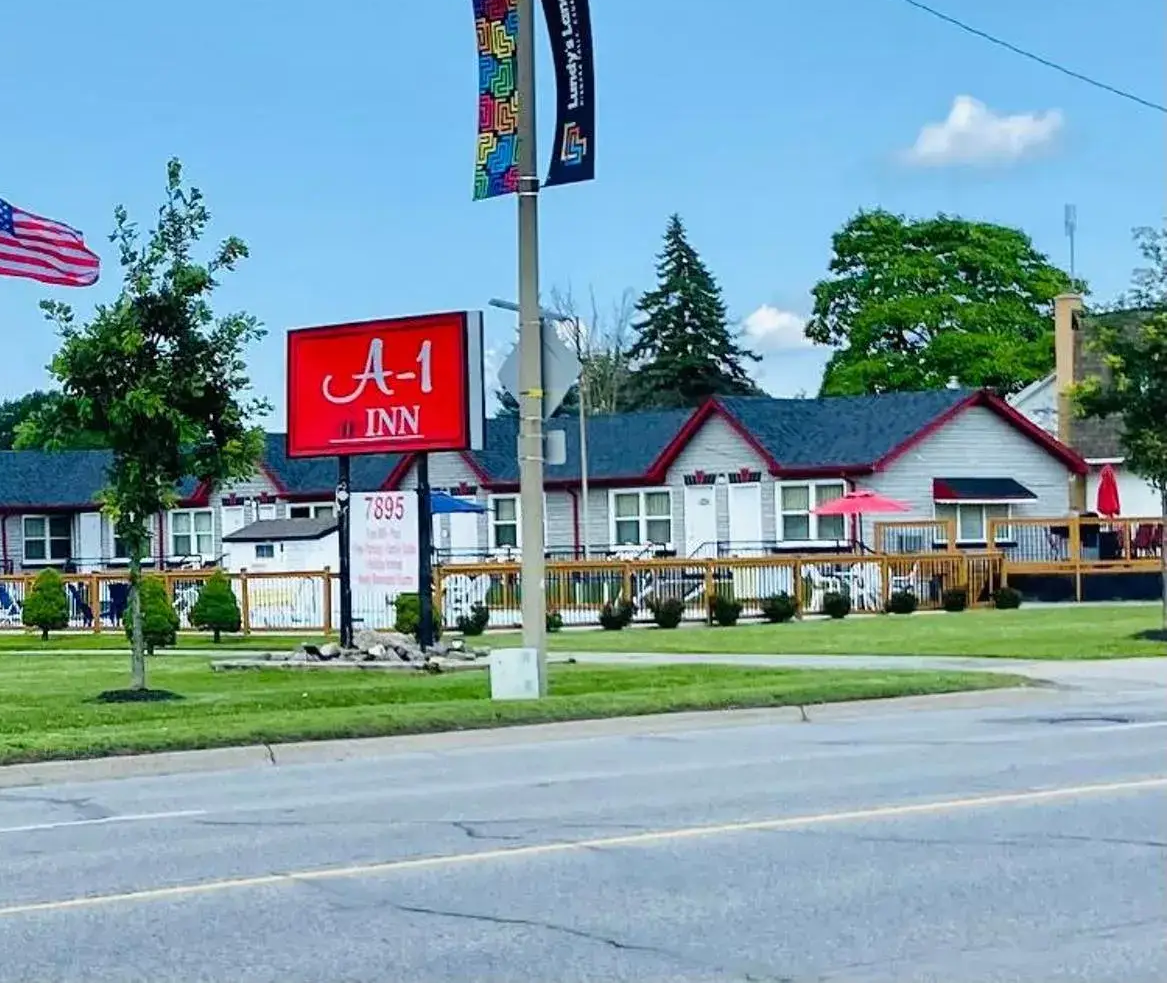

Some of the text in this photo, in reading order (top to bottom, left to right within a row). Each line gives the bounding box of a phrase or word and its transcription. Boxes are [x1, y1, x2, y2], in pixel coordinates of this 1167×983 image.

[564, 38, 581, 110] Lundy's
[322, 338, 432, 404] A-1
[364, 405, 421, 437] INN
[364, 496, 405, 521] 7895
